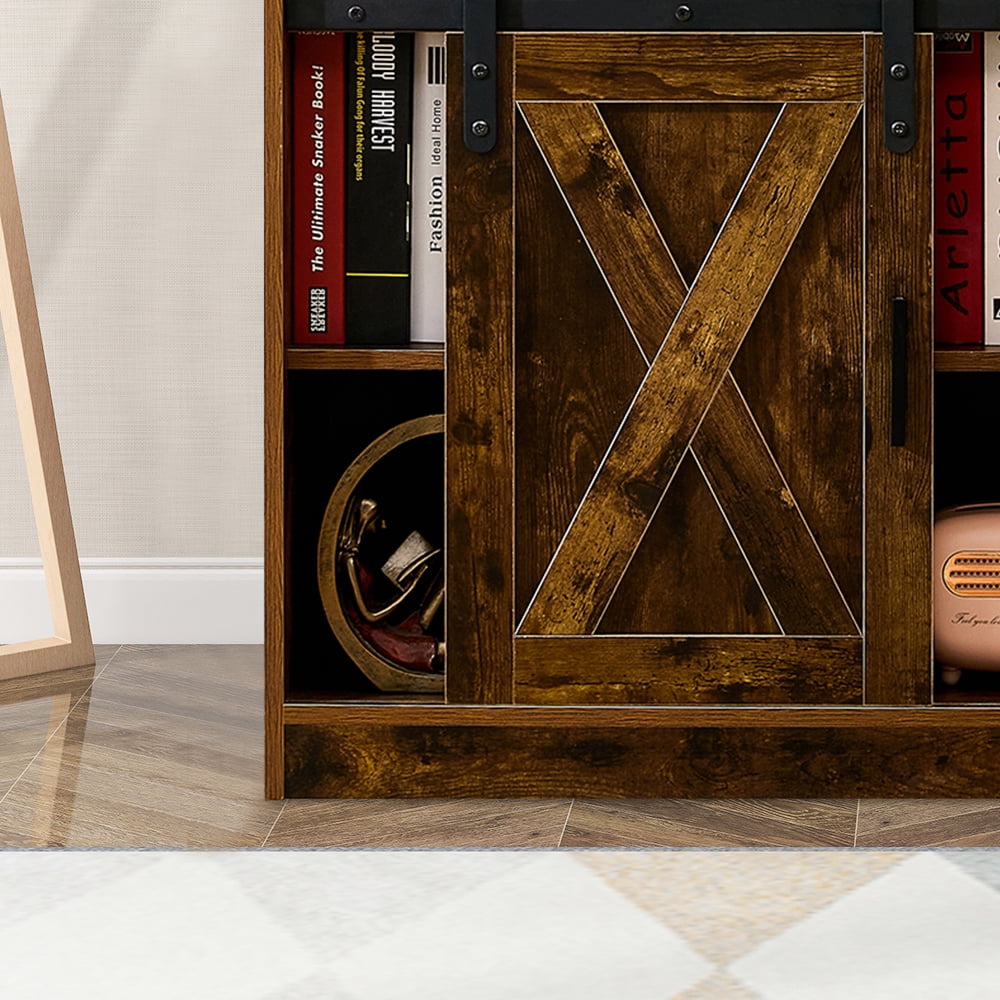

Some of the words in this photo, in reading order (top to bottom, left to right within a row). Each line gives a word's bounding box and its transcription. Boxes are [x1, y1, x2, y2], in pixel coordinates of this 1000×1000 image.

[354, 40, 366, 65] killing
[310, 65, 324, 110] Book!
[356, 77, 365, 98] Falun
[354, 99, 365, 121] Gong
[371, 90, 395, 152] HARVEST
[431, 99, 442, 132] Home
[355, 121, 365, 133] for
[310, 114, 324, 168] Snaker
[355, 134, 365, 154] their
[431, 137, 442, 165] Ideal
[353, 154, 363, 181] organs
[429, 176, 443, 253] Fashion
[937, 93, 968, 315] Arletta
[310, 246, 324, 272] The
